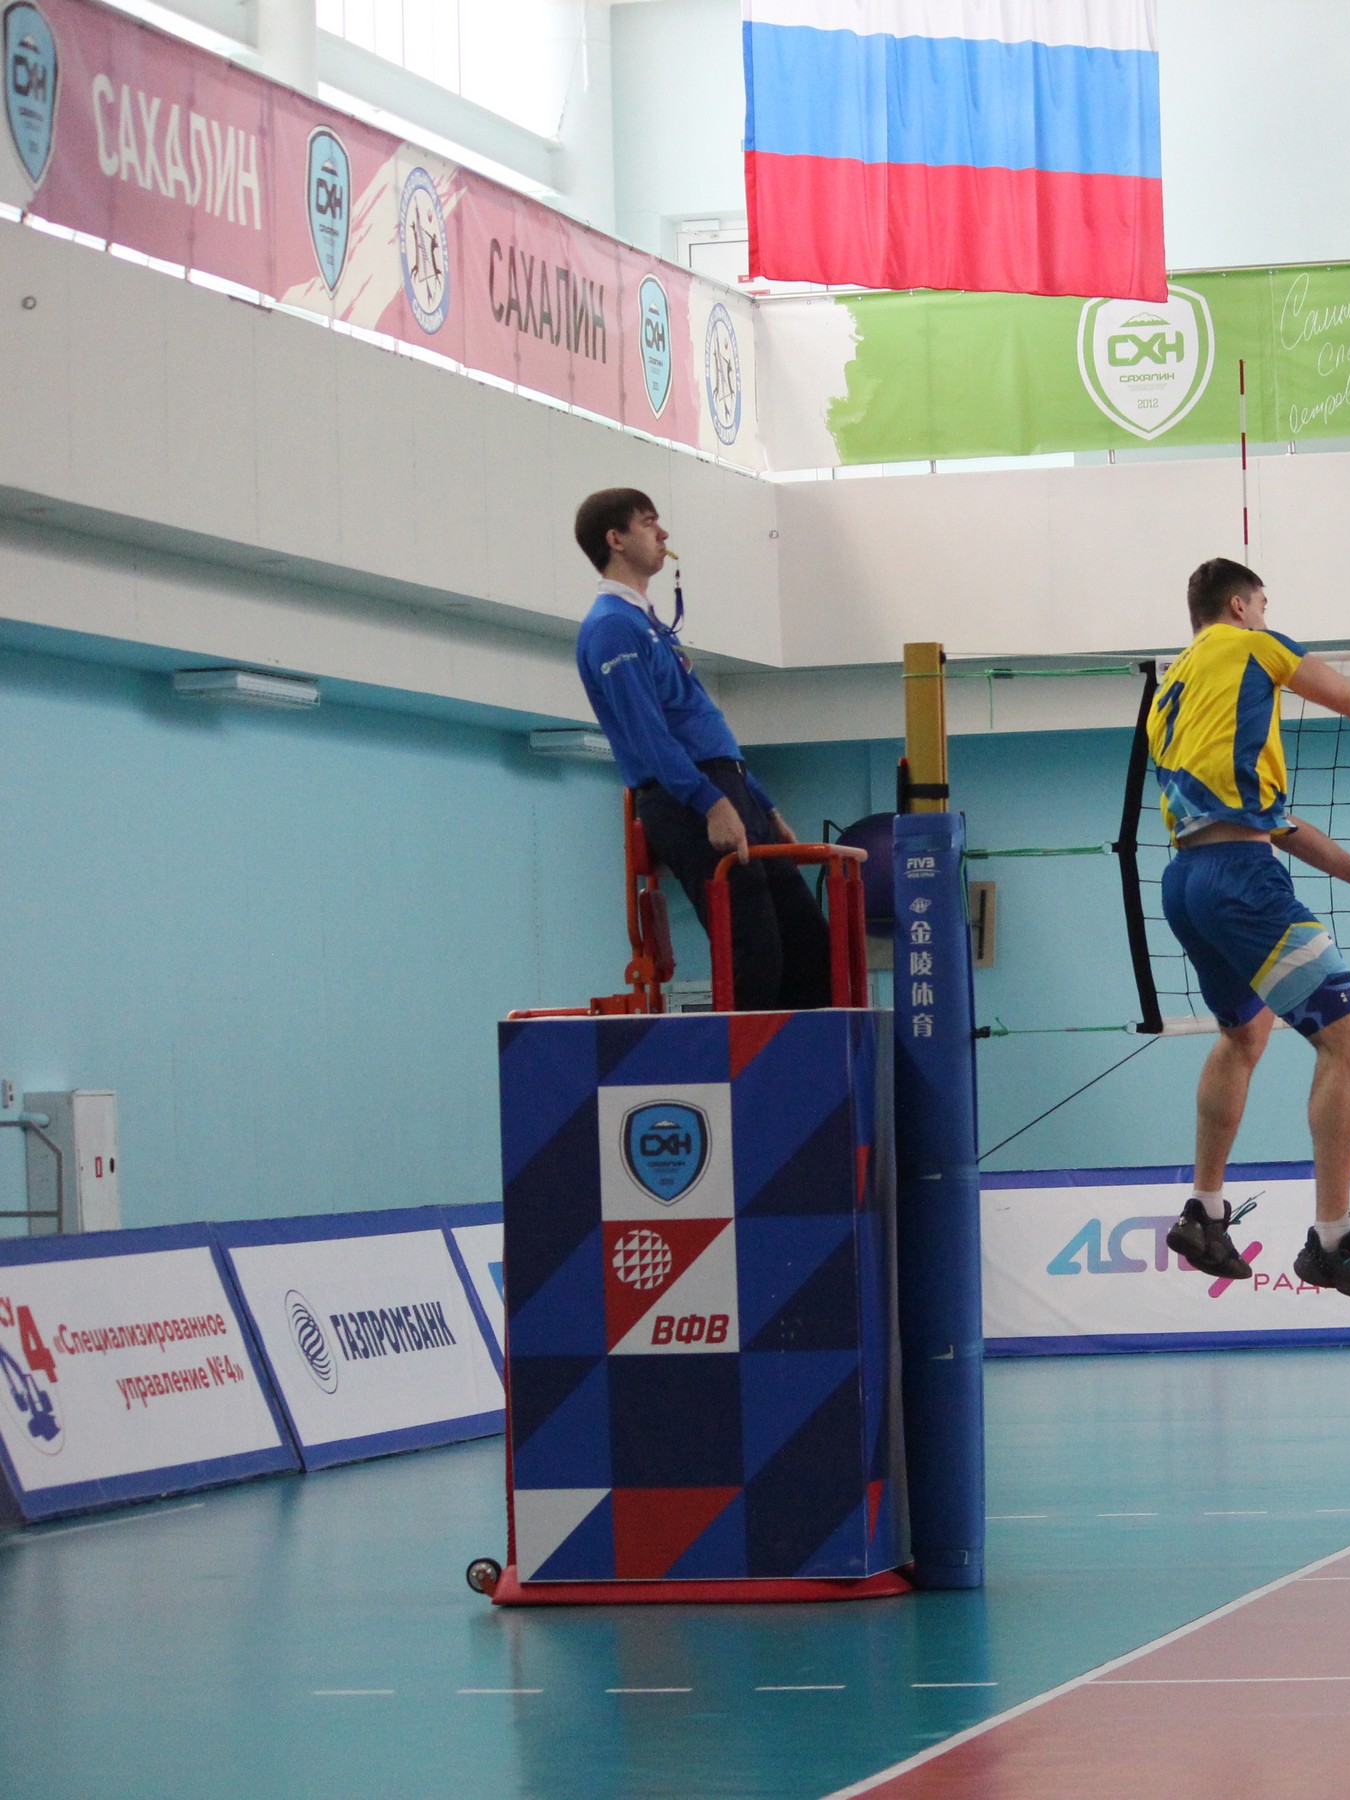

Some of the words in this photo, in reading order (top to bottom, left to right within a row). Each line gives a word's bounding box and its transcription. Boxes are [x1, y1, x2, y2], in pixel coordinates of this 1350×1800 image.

[92, 73, 261, 231] САХАЛИН
[489, 237, 607, 364] САХАЛИН
[1119, 372, 1176, 383] САХАЛИН
[1137, 398, 1160, 409] 2012
[52, 1313, 228, 1355] «Специализированное
[328, 1301, 457, 1362] ГАЗПРОМБАНК
[651, 1314, 730, 1346] ВФВ
[116, 1366, 211, 1411] управление
